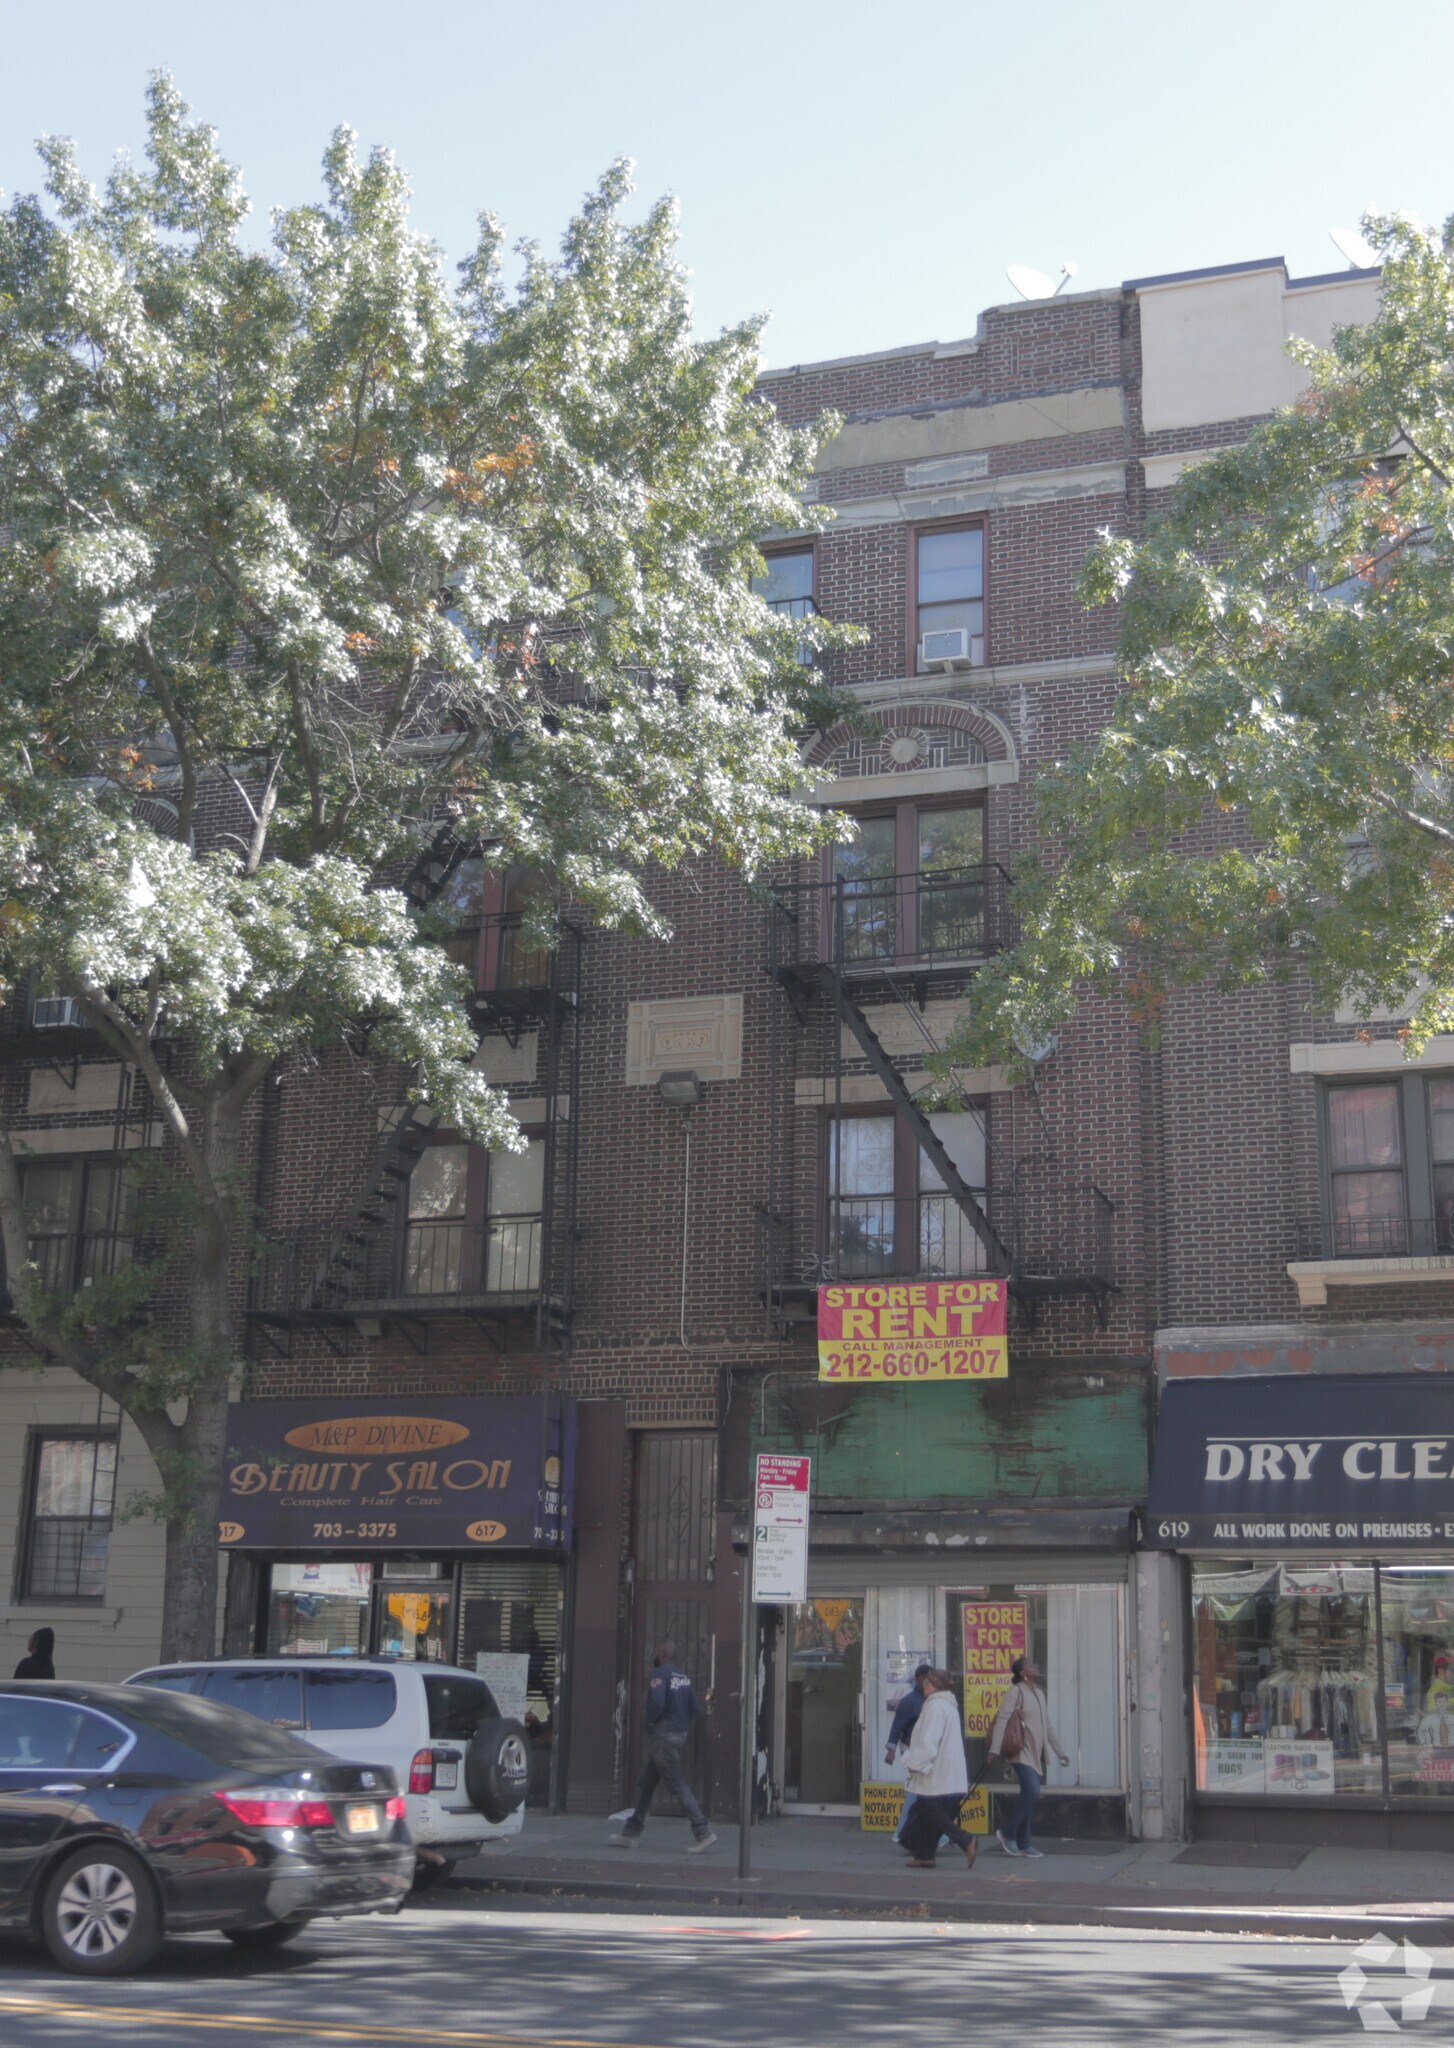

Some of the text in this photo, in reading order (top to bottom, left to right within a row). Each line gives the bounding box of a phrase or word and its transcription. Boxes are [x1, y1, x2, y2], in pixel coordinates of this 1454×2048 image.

[825, 1282, 1000, 1307] STORE FOR
[841, 1305, 983, 1339] RENT
[842, 1339, 984, 1351] CALL MANAGEMENT
[826, 1349, 1001, 1377] 212-660-1207
[311, 1425, 442, 1446] M&P DIVINE
[760, 1458, 802, 1467] NO STANDING
[1204, 1441, 1454, 1481] DRY CLE
[229, 1459, 512, 1495] BEAUTY SALON
[760, 1467, 797, 1476] Monday Friday
[280, 1496, 443, 1508] Complete Hair Care
[219, 1526, 236, 1537] 17
[475, 1525, 497, 1537] 617
[757, 1526, 766, 1541] 2
[1158, 1521, 1190, 1538] 619
[1213, 1523, 1238, 1538] ALL
[1241, 1523, 1286, 1538] WORK
[1290, 1522, 1331, 1537] DONE
[1335, 1522, 1358, 1537] ON
[1362, 1522, 1432, 1537] PREMISES
[966, 1607, 1024, 1625] STORE
[977, 1628, 1012, 1646] FOR
[966, 1648, 1024, 1670] RENT
[968, 1676, 1010, 1685] CALL MG
[968, 1714, 991, 1732] 660
[1267, 1744, 1291, 1752] LEATHER
[1218, 1763, 1243, 1774] RUGS
[864, 1788, 887, 1798] PHONE
[864, 1802, 896, 1813] NOTARY
[961, 1806, 986, 1822] HIRTS
[865, 1815, 890, 1826] TAXES
